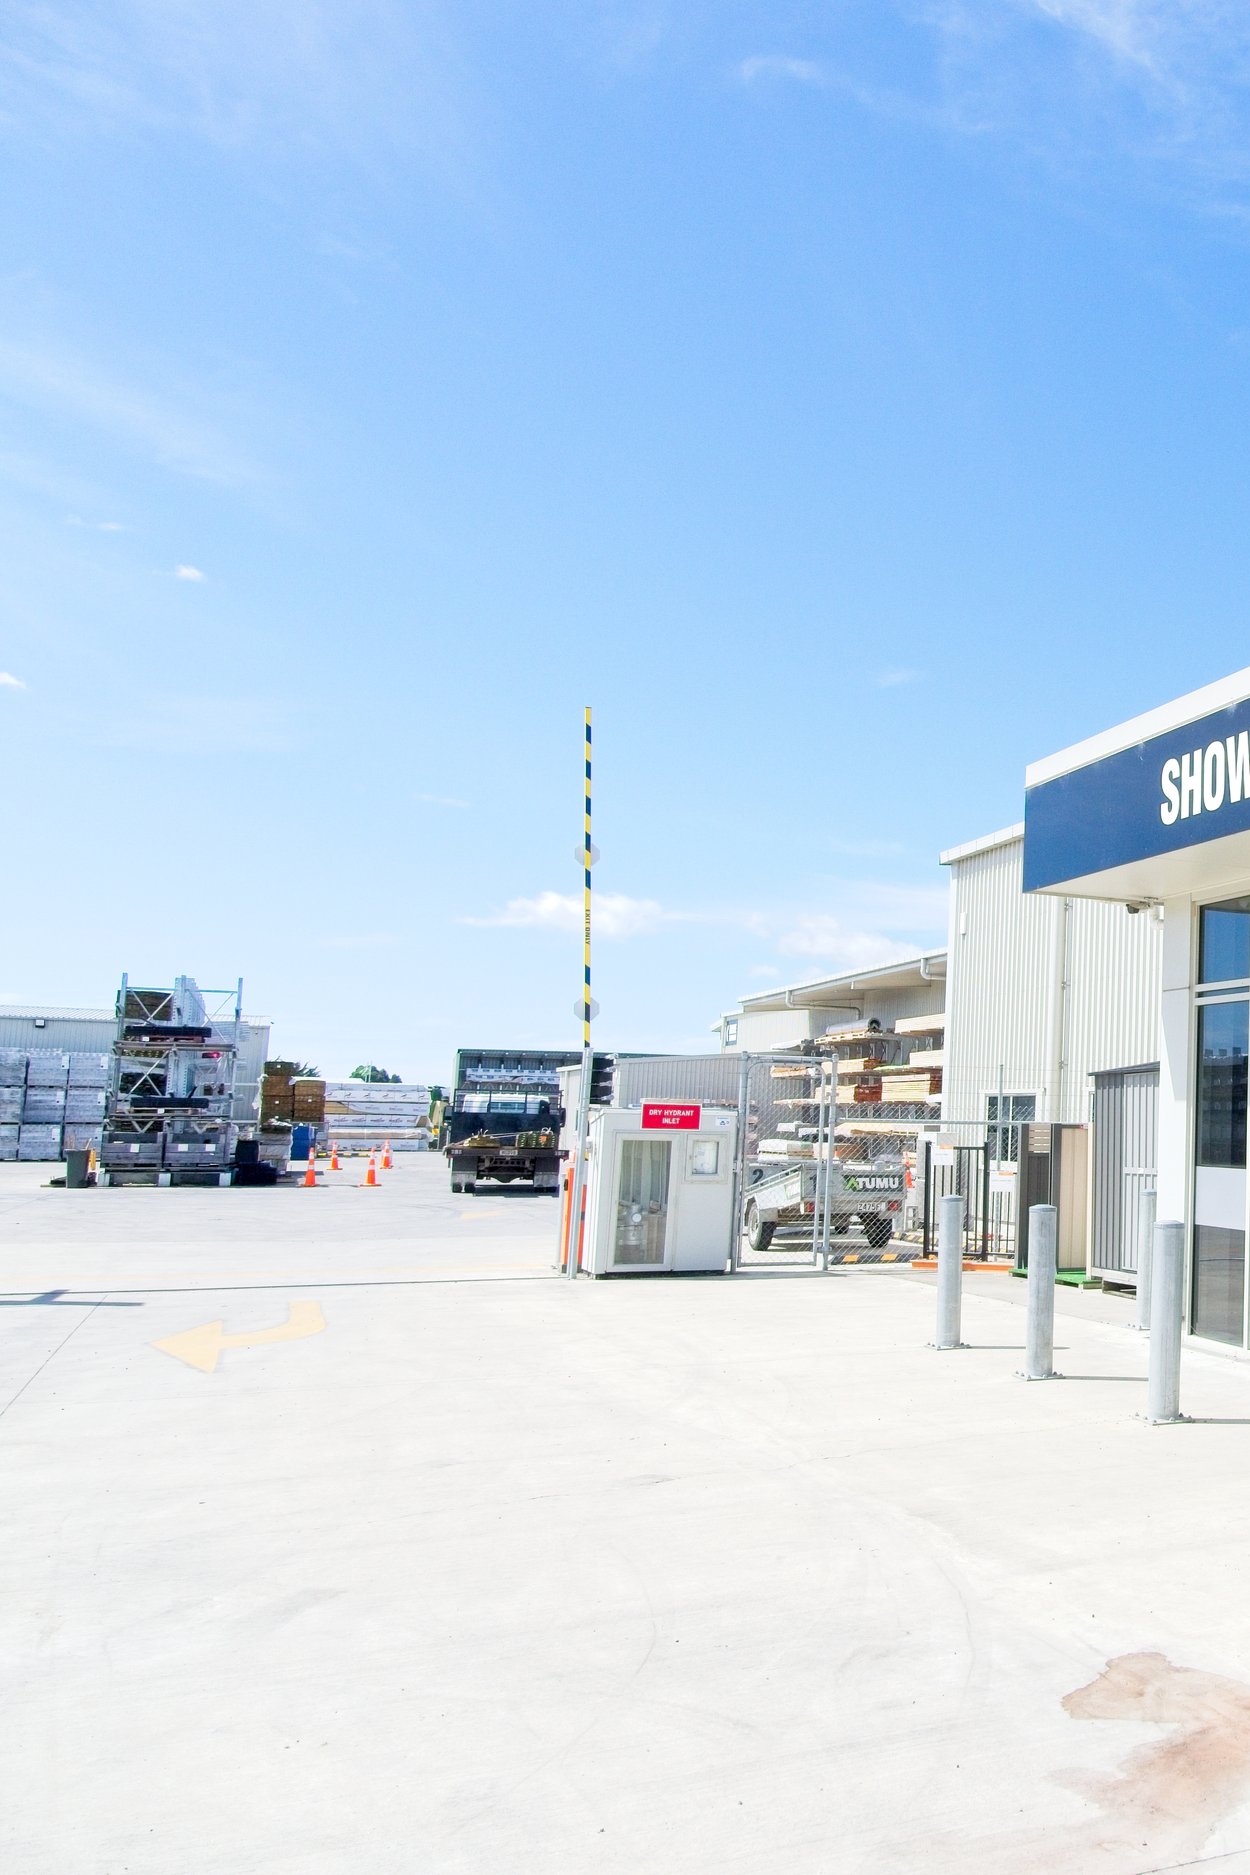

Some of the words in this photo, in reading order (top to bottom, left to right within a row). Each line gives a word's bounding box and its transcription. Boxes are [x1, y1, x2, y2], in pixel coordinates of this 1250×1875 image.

[664, 1109, 694, 1117] HYDRANT
[662, 1117, 680, 1125] INLET
[856, 1177, 899, 1189] TUMU
